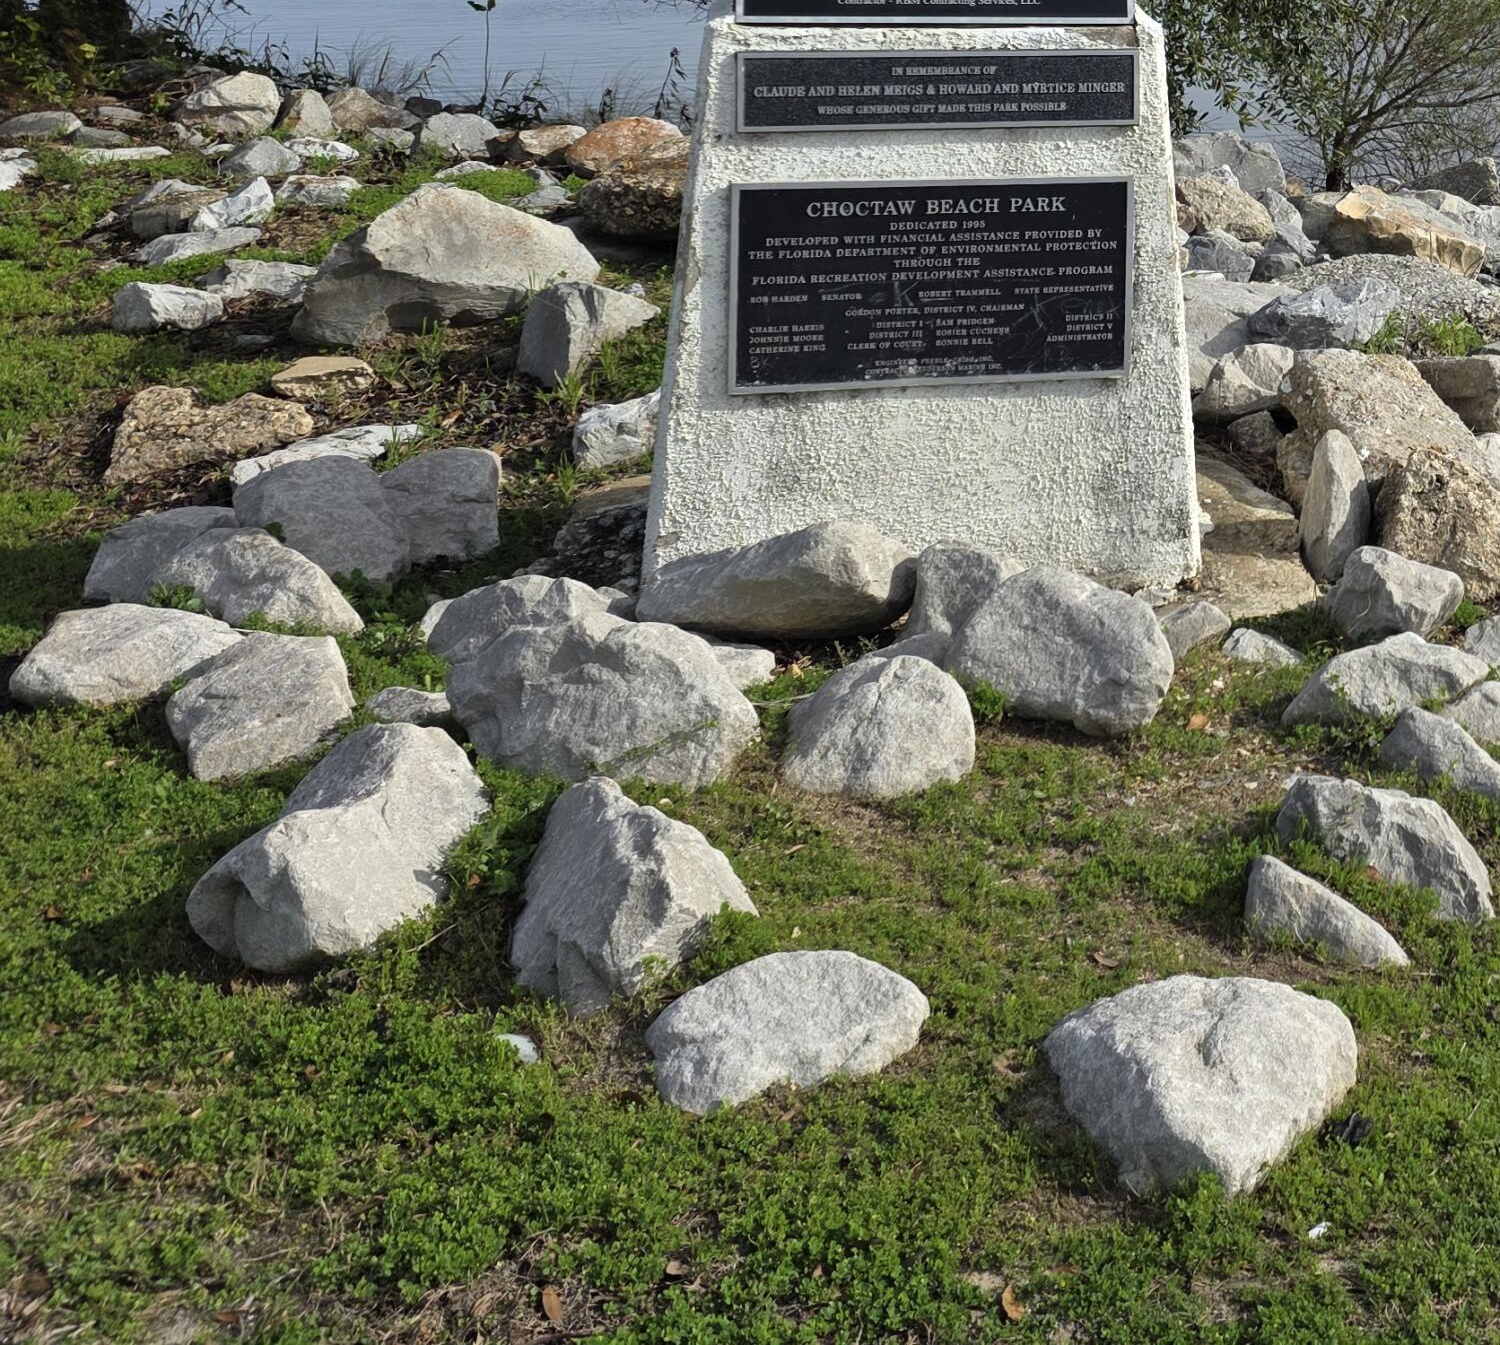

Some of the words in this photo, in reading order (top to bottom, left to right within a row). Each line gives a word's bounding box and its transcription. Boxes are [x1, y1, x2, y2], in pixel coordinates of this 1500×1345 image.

[891, 67, 903, 76] IN
[906, 67, 980, 76] REMEMBRANCE
[983, 66, 996, 75] OF
[754, 87, 805, 97] CLAUDE
[808, 86, 834, 97] AND
[838, 85, 879, 96] HELEN
[884, 84, 923, 95] MEIGS
[927, 84, 936, 94] &
[939, 84, 990, 95] HOWARD
[994, 83, 1019, 94] AND
[1022, 82, 1075, 93] MYRTICE
[1078, 82, 1124, 93] MINGER
[818, 105, 853, 114] WHOSE
[856, 104, 909, 114] GENEROUS
[912, 104, 935, 113] GIFT
[938, 103, 965, 113] MADE
[968, 103, 991, 112] THIS
[993, 102, 1018, 112] PARK
[1021, 102, 1066, 111] POSSIBLE
[806, 201, 915, 217] CHOCTAW
[926, 199, 998, 215] BEACH
[1009, 197, 1066, 212] PARK
[890, 221, 957, 230] DEDICATED
[962, 220, 985, 229] 1995
[766, 236, 838, 246] DEVELOPED
[843, 235, 875, 244] WITH
[880, 233, 945, 243] FINANCIAL
[950, 231, 1020, 241] ASSISTANCE
[1025, 229, 1082, 240] PROVIDED
[1087, 229, 1102, 239] BY
[749, 250, 773, 260] THE
[778, 249, 831, 259] FLORIDA
[836, 247, 916, 257] DEPARTMENT
[921, 246, 937, 254] OF
[941, 243, 1041, 254] ENVIRONMENTAL
[1046, 241, 1117, 252] PROTECTION
[894, 258, 952, 268] THROUGH
[957, 257, 980, 266] THE
[752, 275, 805, 285] FLORIDA
[811, 272, 887, 283] RECREATION
[892, 270, 979, 281] DEVELOPMENT
[984, 267, 1054, 278] ASSISTANCE
[1059, 265, 1112, 276] PROGRAM
[1043, 285, 1113, 293] REPRESENTATIVE
[822, 293, 862, 301] SENATOR
[749, 325, 789, 333] CHARLIE
[792, 324, 824, 332] HARRIS
[793, 334, 824, 342] MOORE
[870, 331, 909, 339] DISTRICT
[1046, 333, 1112, 342] ADMINISTRATOR
[749, 345, 799, 354] CATHERINE
[803, 344, 826, 352] KING
[847, 342, 876, 350] CLERK
